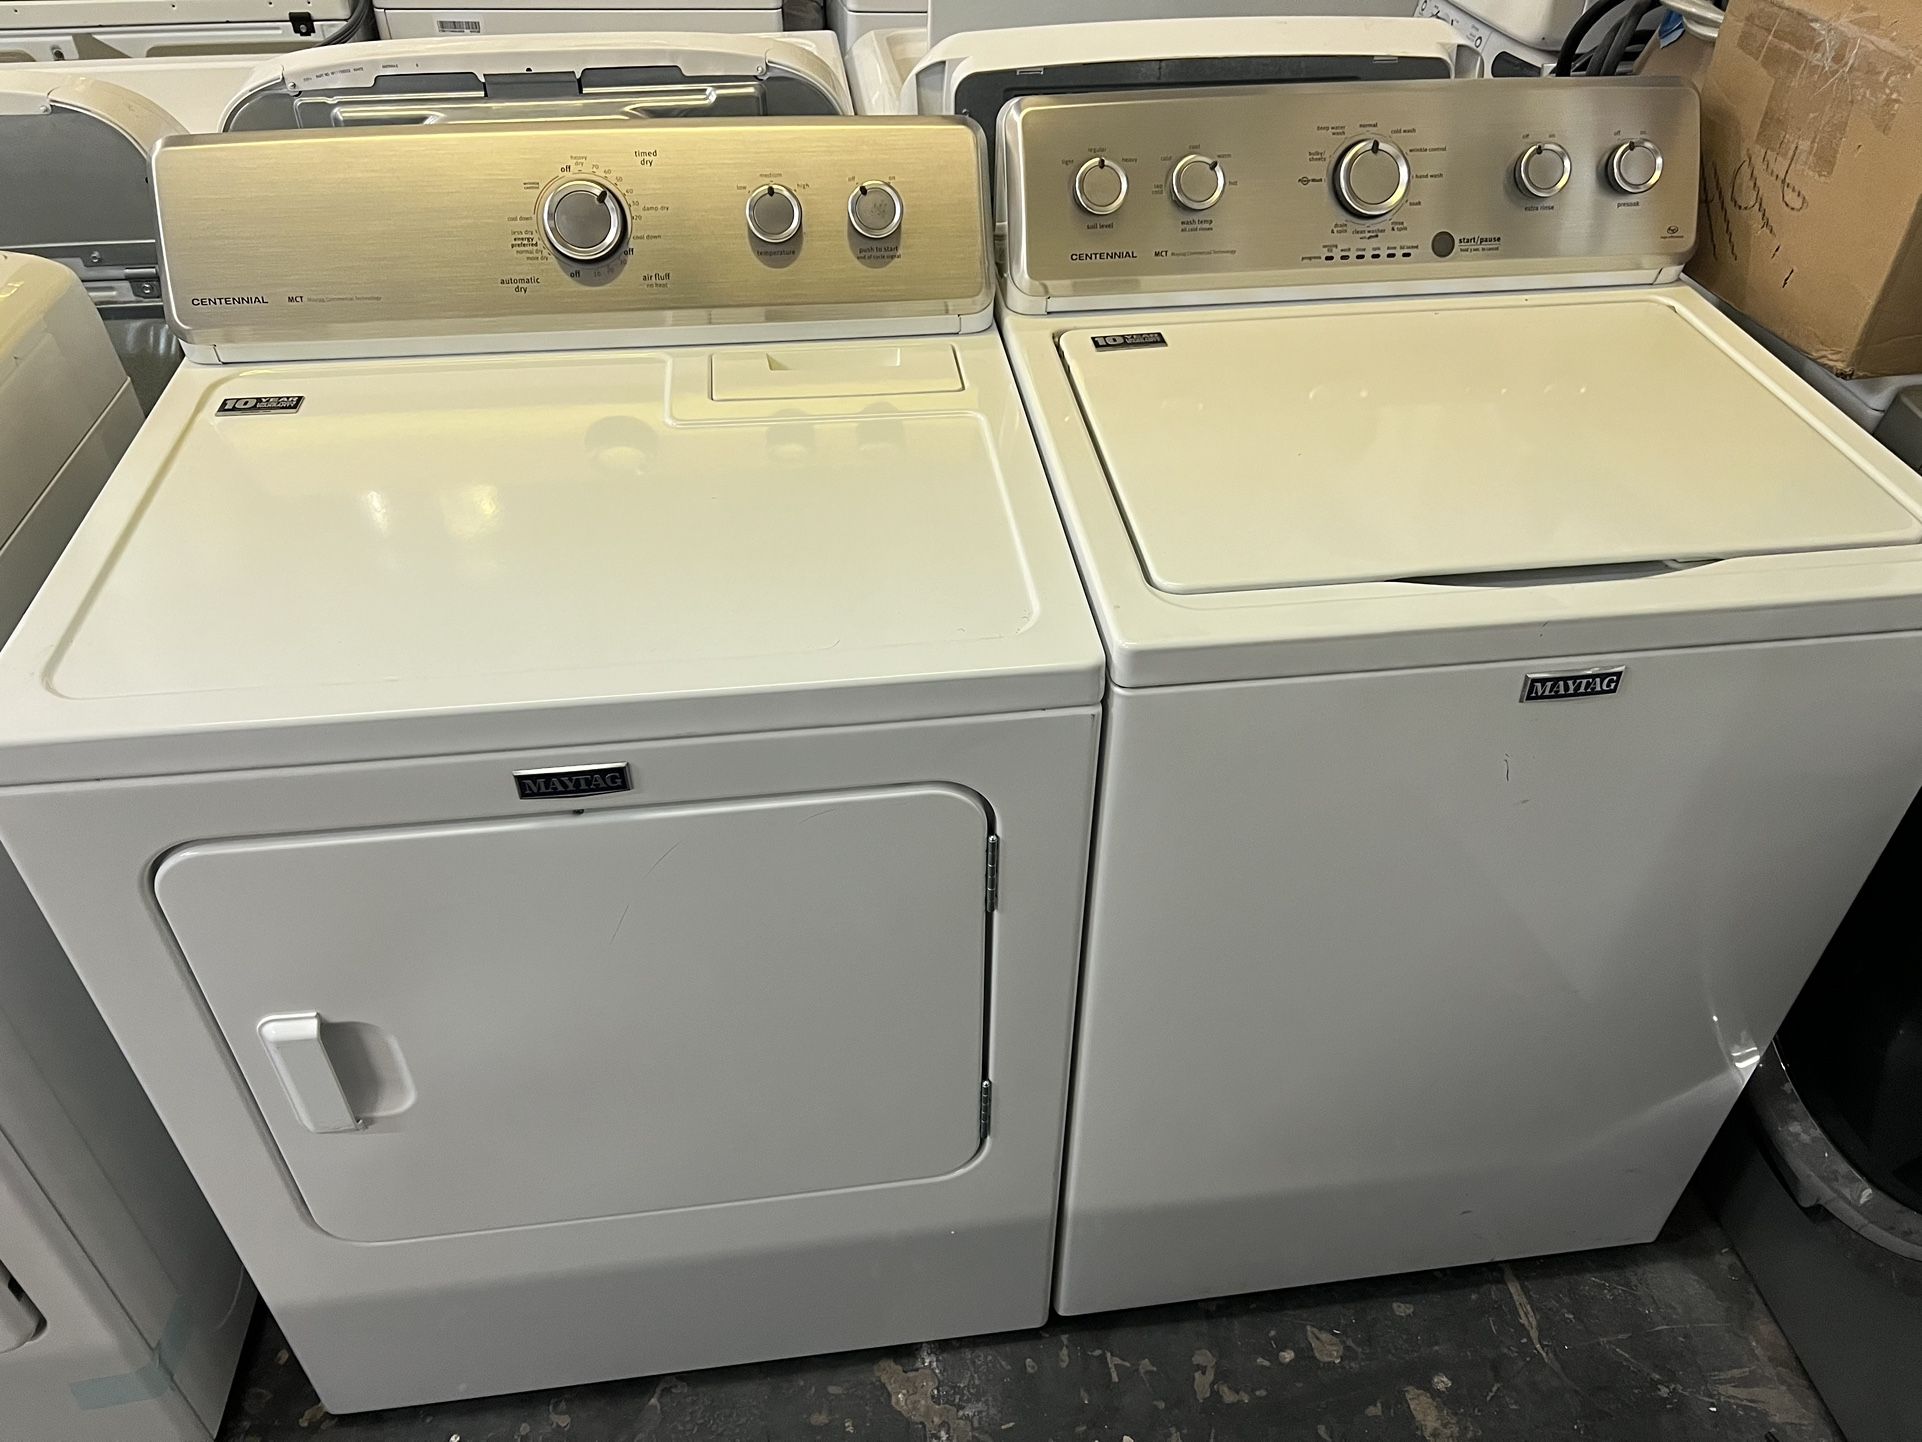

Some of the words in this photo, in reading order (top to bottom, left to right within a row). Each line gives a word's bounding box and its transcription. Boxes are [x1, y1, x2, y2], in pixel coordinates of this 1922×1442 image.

[634, 149, 658, 158] timed
[640, 158, 654, 167] dry
[1061, 158, 1074, 166] light
[560, 165, 571, 173] off
[796, 182, 810, 190] high
[660, 203, 669, 211] dry
[1616, 200, 1640, 209] presoak
[1086, 222, 1098, 230] soil
[1099, 221, 1114, 229] level
[1197, 218, 1214, 226] temp
[1458, 235, 1502, 245] start/pause
[510, 241, 538, 249] preferred
[623, 247, 634, 256] off
[756, 249, 796, 258] temperature
[1070, 250, 1138, 262] CENTENNIAL
[1154, 249, 1169, 258] MCT
[569, 270, 580, 278] off
[642, 273, 653, 281] air
[654, 272, 671, 281] fluff
[500, 276, 541, 285] automatic
[514, 285, 528, 294] dry
[191, 296, 269, 307] CENTENNIAL
[287, 295, 304, 303] MCT
[1094, 336, 1125, 346] 10
[224, 398, 257, 410] 10
[1530, 676, 1617, 697] MAYTAG
[521, 772, 623, 794] MAYTAG
